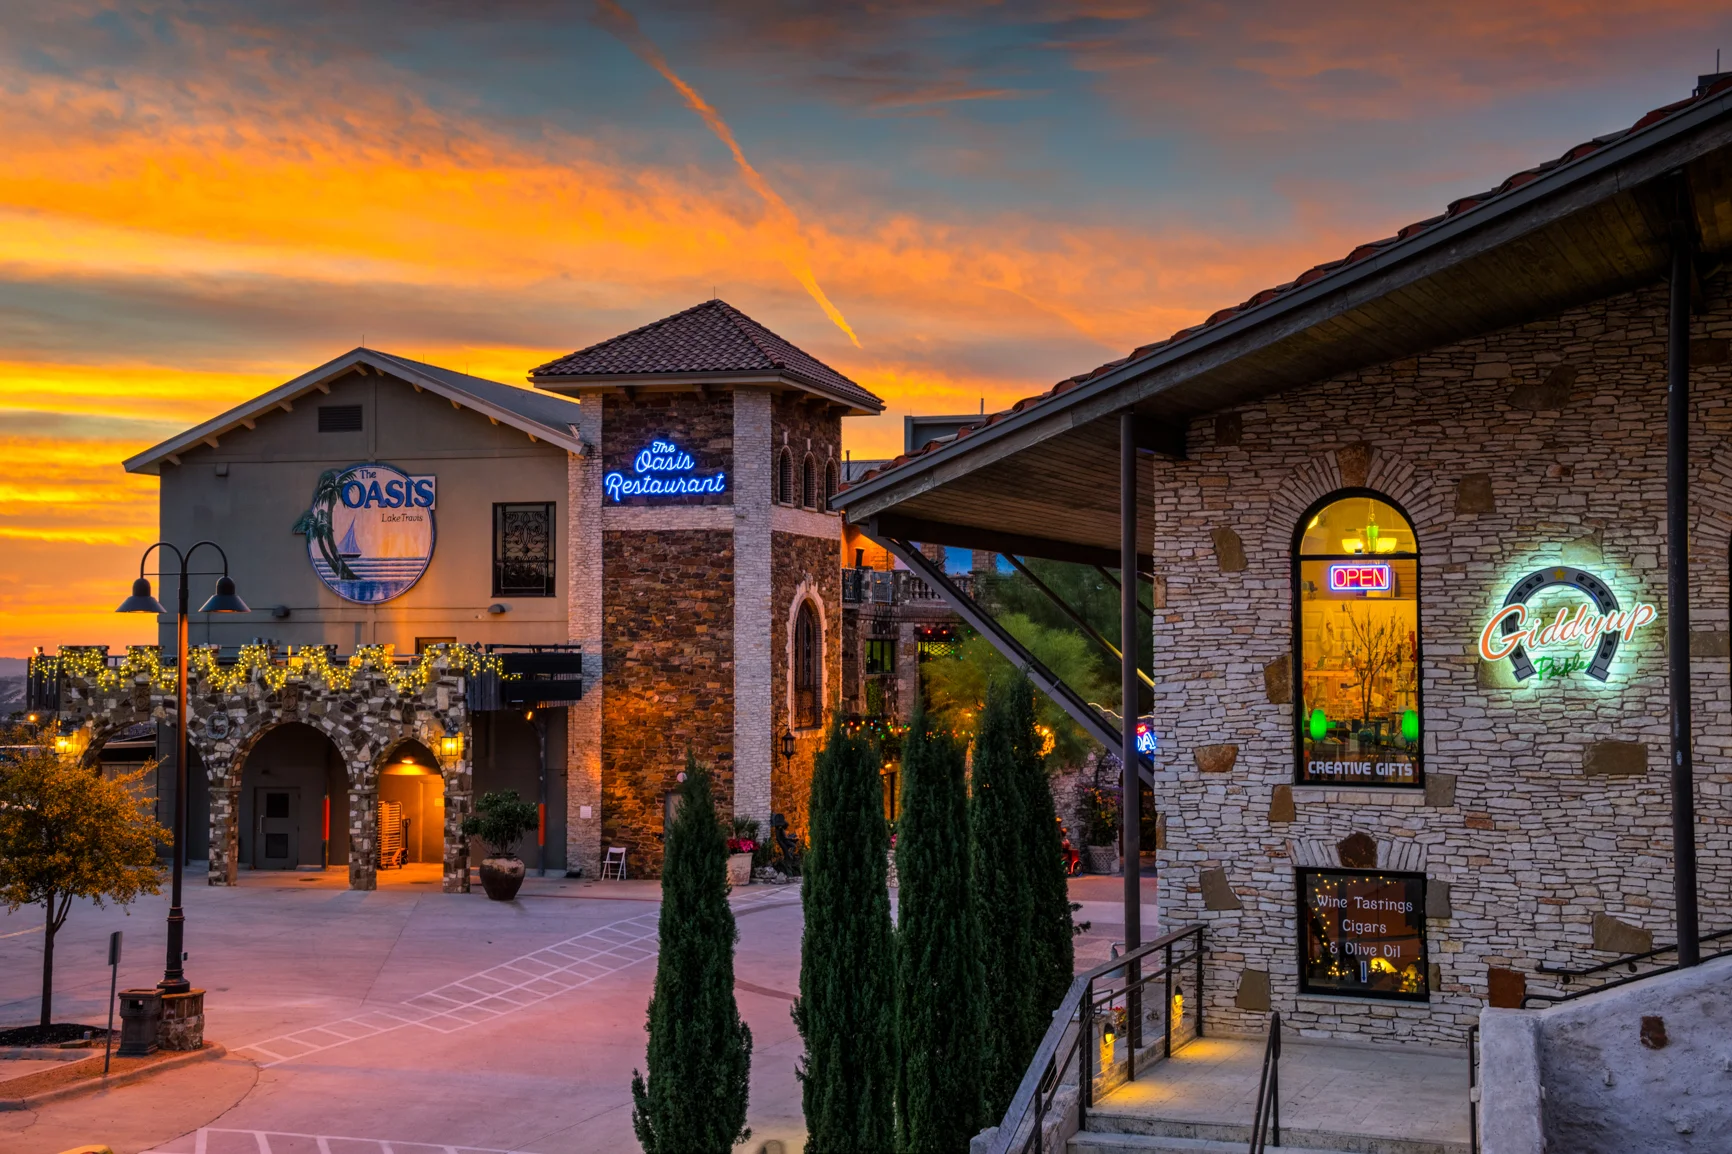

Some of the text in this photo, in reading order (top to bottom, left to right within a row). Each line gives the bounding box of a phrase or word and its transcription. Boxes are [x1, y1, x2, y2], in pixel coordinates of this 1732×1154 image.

[651, 440, 676, 454] The
[635, 450, 695, 473] Oasis
[360, 469, 377, 480] The
[341, 479, 435, 509] OASIS
[605, 472, 725, 502] Restaurant
[381, 513, 423, 523] Lake Travis
[1333, 568, 1387, 588] OPEN
[1480, 602, 1658, 661] Giddyup
[1307, 760, 1413, 777] CREATIVE GIFTS
[1316, 894, 1413, 914] Wine Tastings
[1342, 919, 1387, 934] Cigars
[1329, 941, 1401, 958] & Olive Oil
